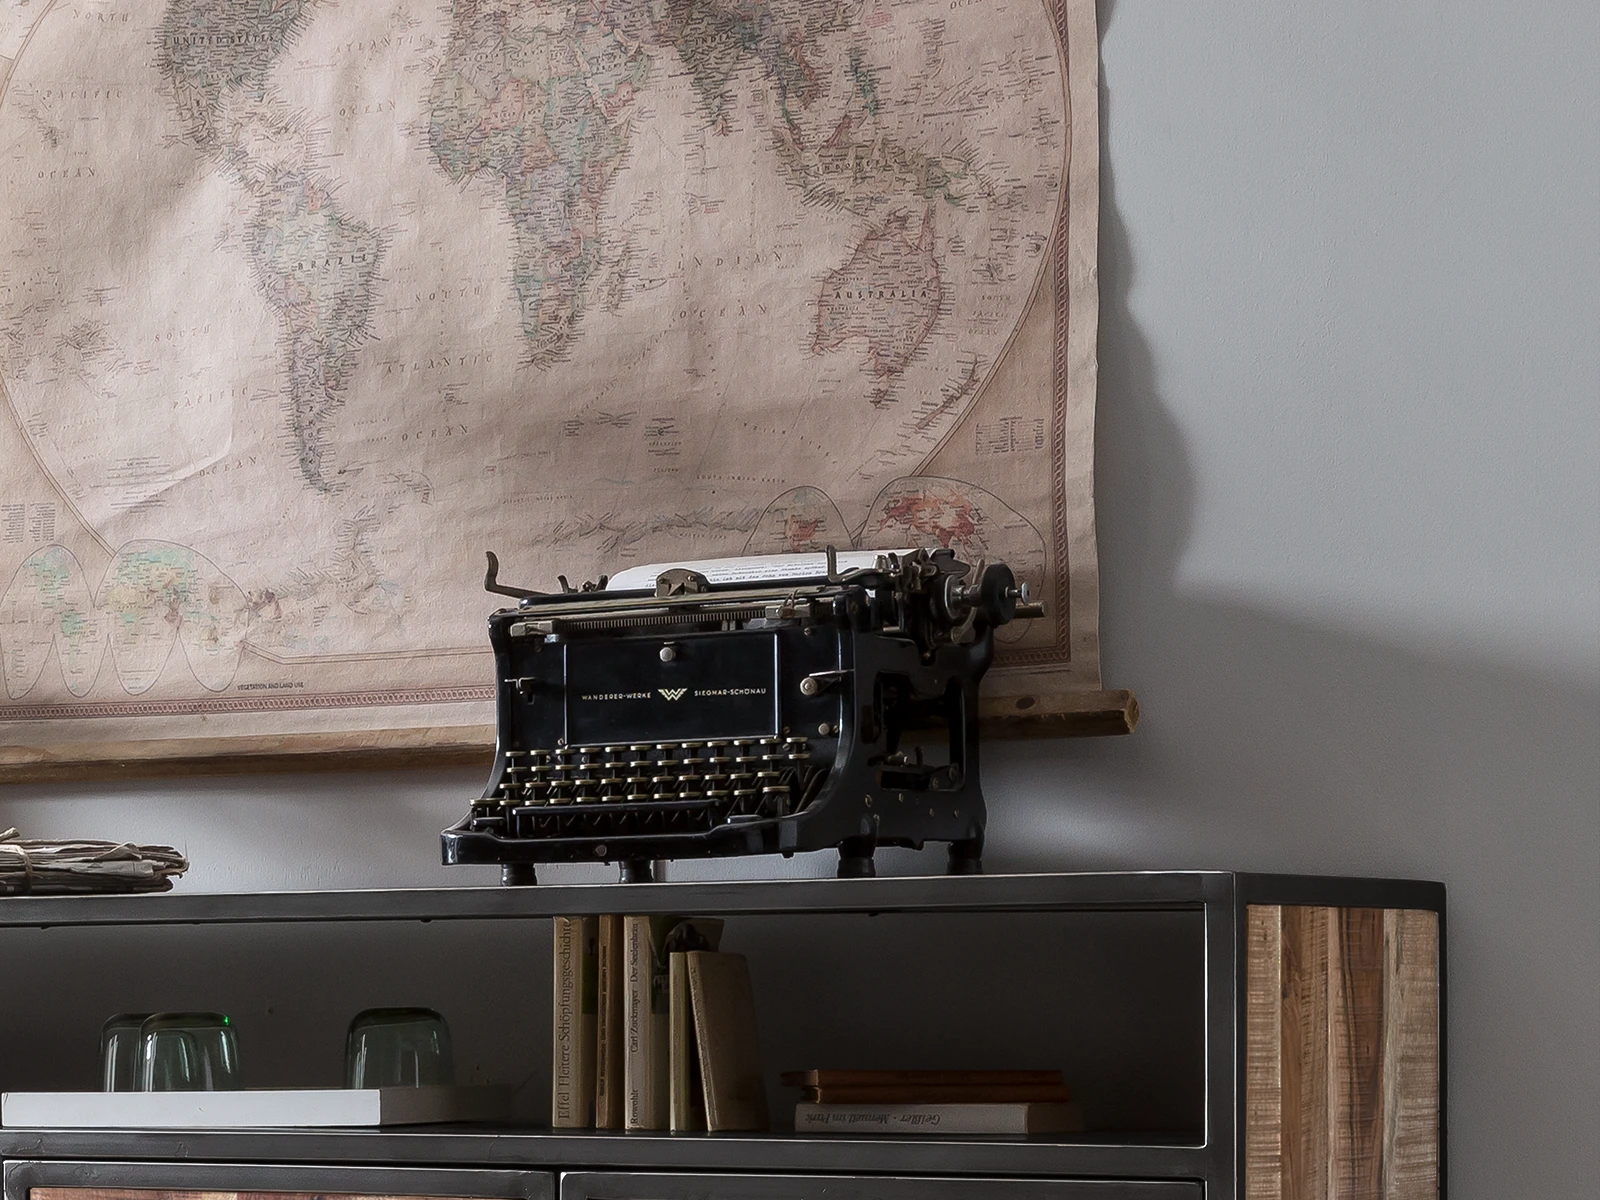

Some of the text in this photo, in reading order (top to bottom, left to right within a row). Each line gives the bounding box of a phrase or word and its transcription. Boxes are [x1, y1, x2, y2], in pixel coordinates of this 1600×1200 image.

[173, 35, 275, 46] UNITED STATES
[695, 33, 730, 46] INDIA
[46, 89, 123, 99] PACIFIC
[339, 100, 397, 117] OCEAN
[37, 168, 96, 180] OCEAN
[297, 254, 368, 271] BRAZIL
[835, 289, 927, 299] AUSTRALIA
[679, 303, 767, 319] OCEAN
[401, 424, 469, 442] OCEAN
[581, 692, 652, 701] WANDERER-WERKE
[630, 966, 639, 983] Der
[630, 989, 641, 1053] Carl Zuckmayer
[558, 1044, 570, 1087] Heitere
[556, 1092, 570, 1119] Effel
[630, 1089, 639, 1124] Rowohlt
[805, 1113, 831, 1124] Park
[847, 1113, 890, 1125] Menuett
[900, 1112, 941, 1126] Geißler
